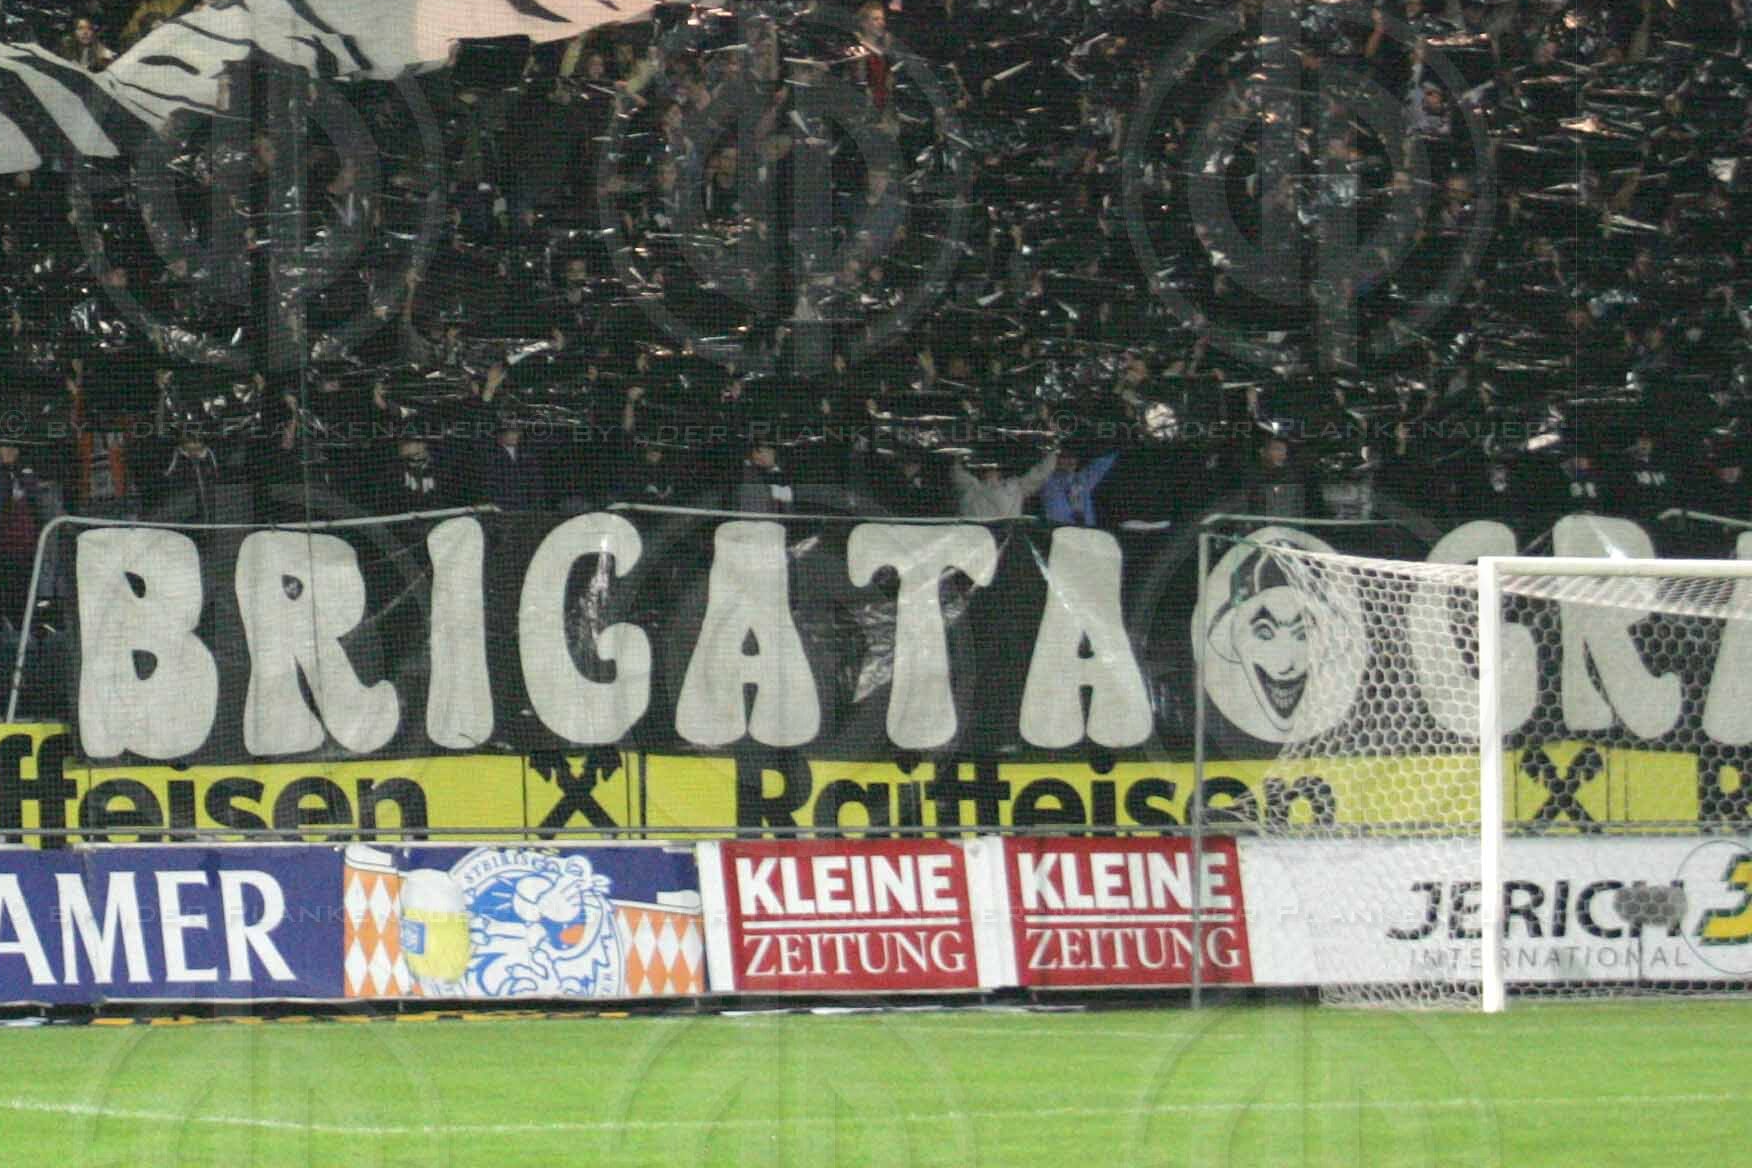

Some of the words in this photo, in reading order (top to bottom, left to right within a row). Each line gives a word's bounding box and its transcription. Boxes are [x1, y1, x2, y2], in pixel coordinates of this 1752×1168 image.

[76, 512, 1154, 761] BRIGATA
[734, 854, 960, 916] KLEINE
[1017, 852, 1234, 912] KLEINE
[742, 930, 968, 977] ZEITUNG
[1025, 927, 1242, 974] ZEITUNG
